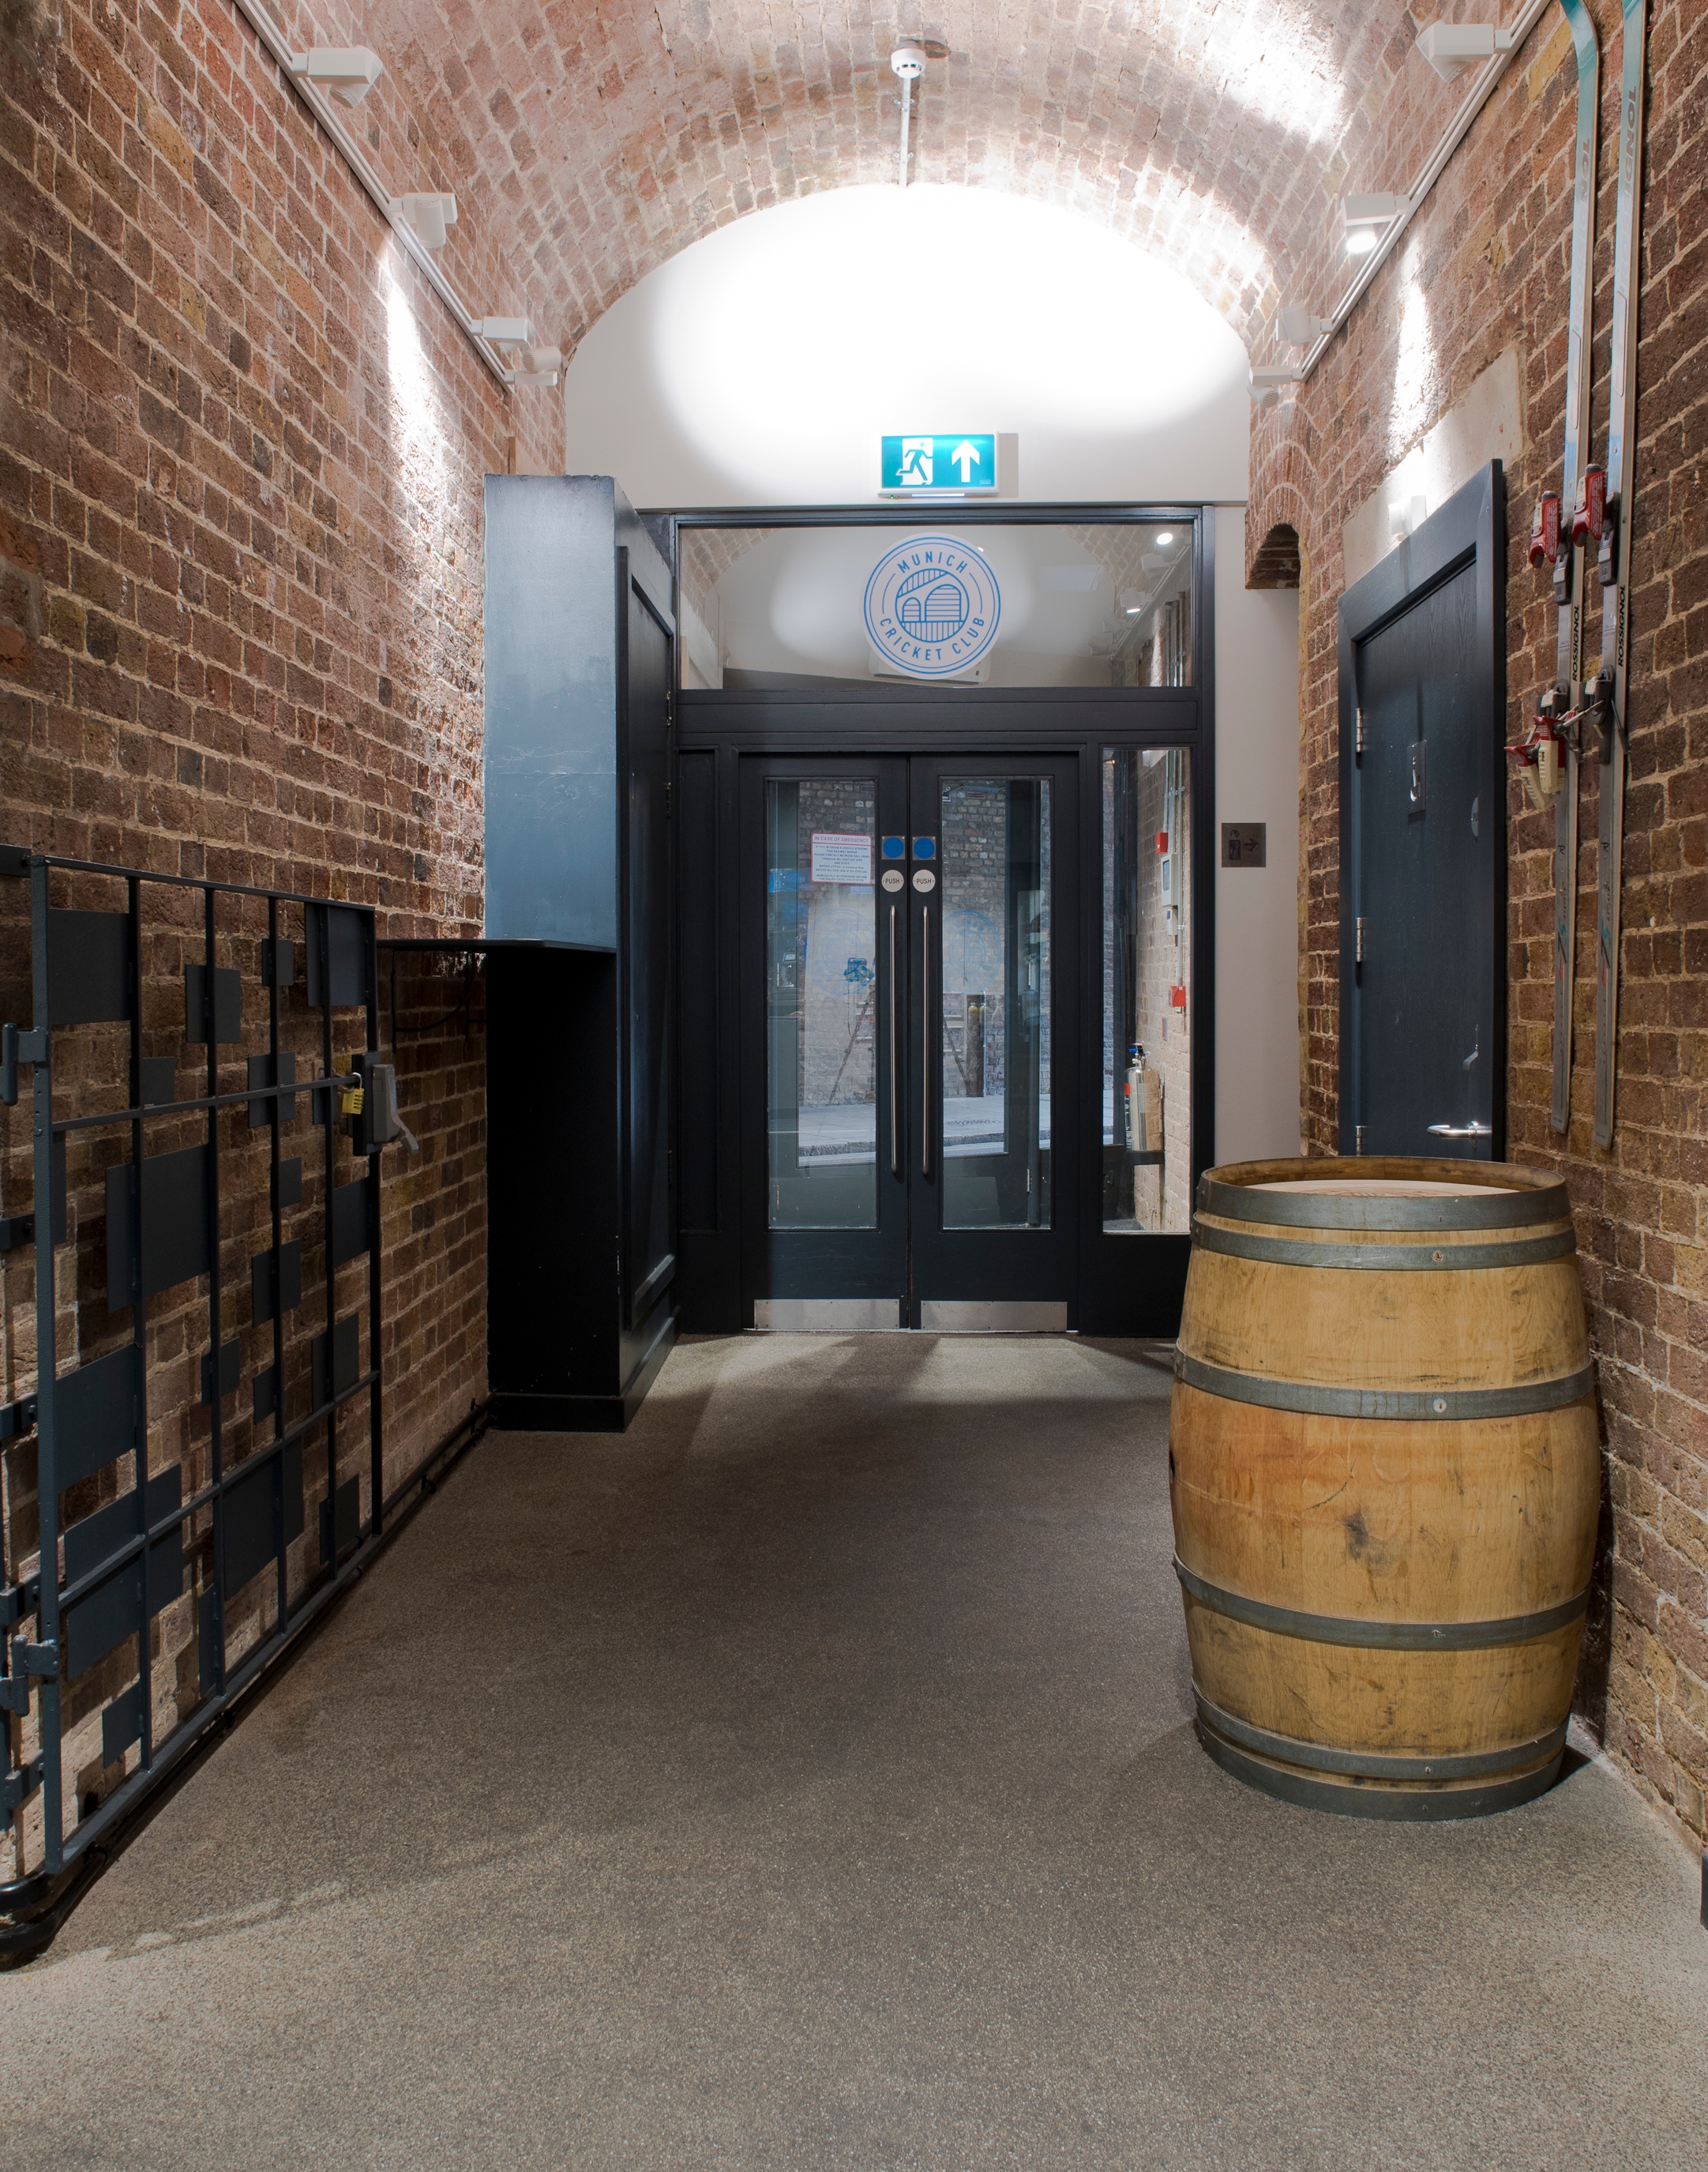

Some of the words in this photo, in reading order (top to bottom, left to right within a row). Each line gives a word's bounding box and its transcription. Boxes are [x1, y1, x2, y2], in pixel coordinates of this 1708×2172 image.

[897, 551, 968, 573] MUNICH
[880, 618, 942, 661] CRICKET
[952, 617, 985, 655] CLUB
